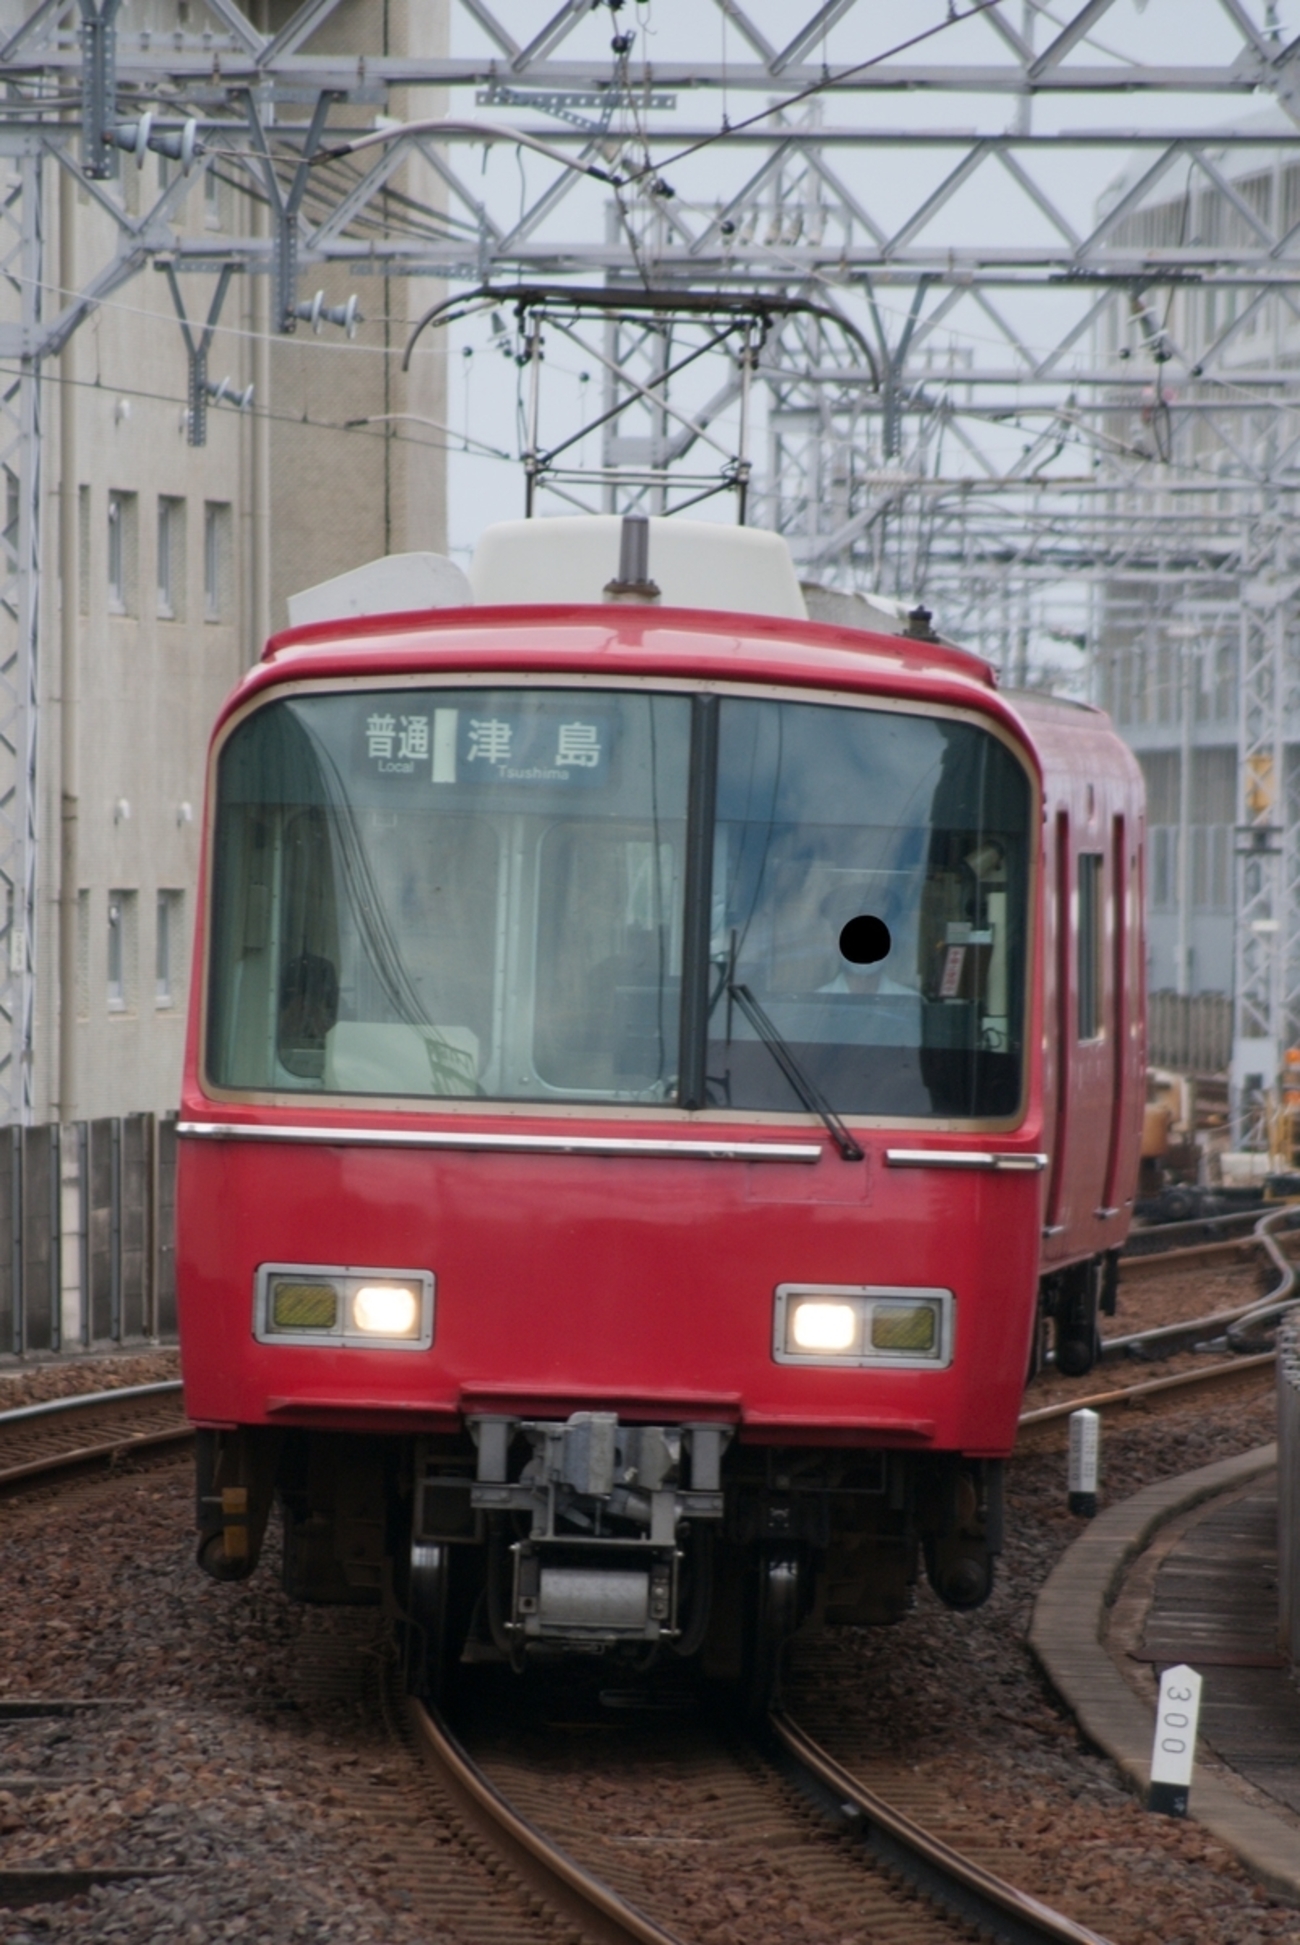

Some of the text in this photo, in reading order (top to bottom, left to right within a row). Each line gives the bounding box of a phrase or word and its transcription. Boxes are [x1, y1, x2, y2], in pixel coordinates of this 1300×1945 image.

[366, 713, 429, 760] 普通
[377, 760, 415, 774] Local
[498, 765, 570, 781] Tsushima
[1161, 1686, 1192, 1755] 300
